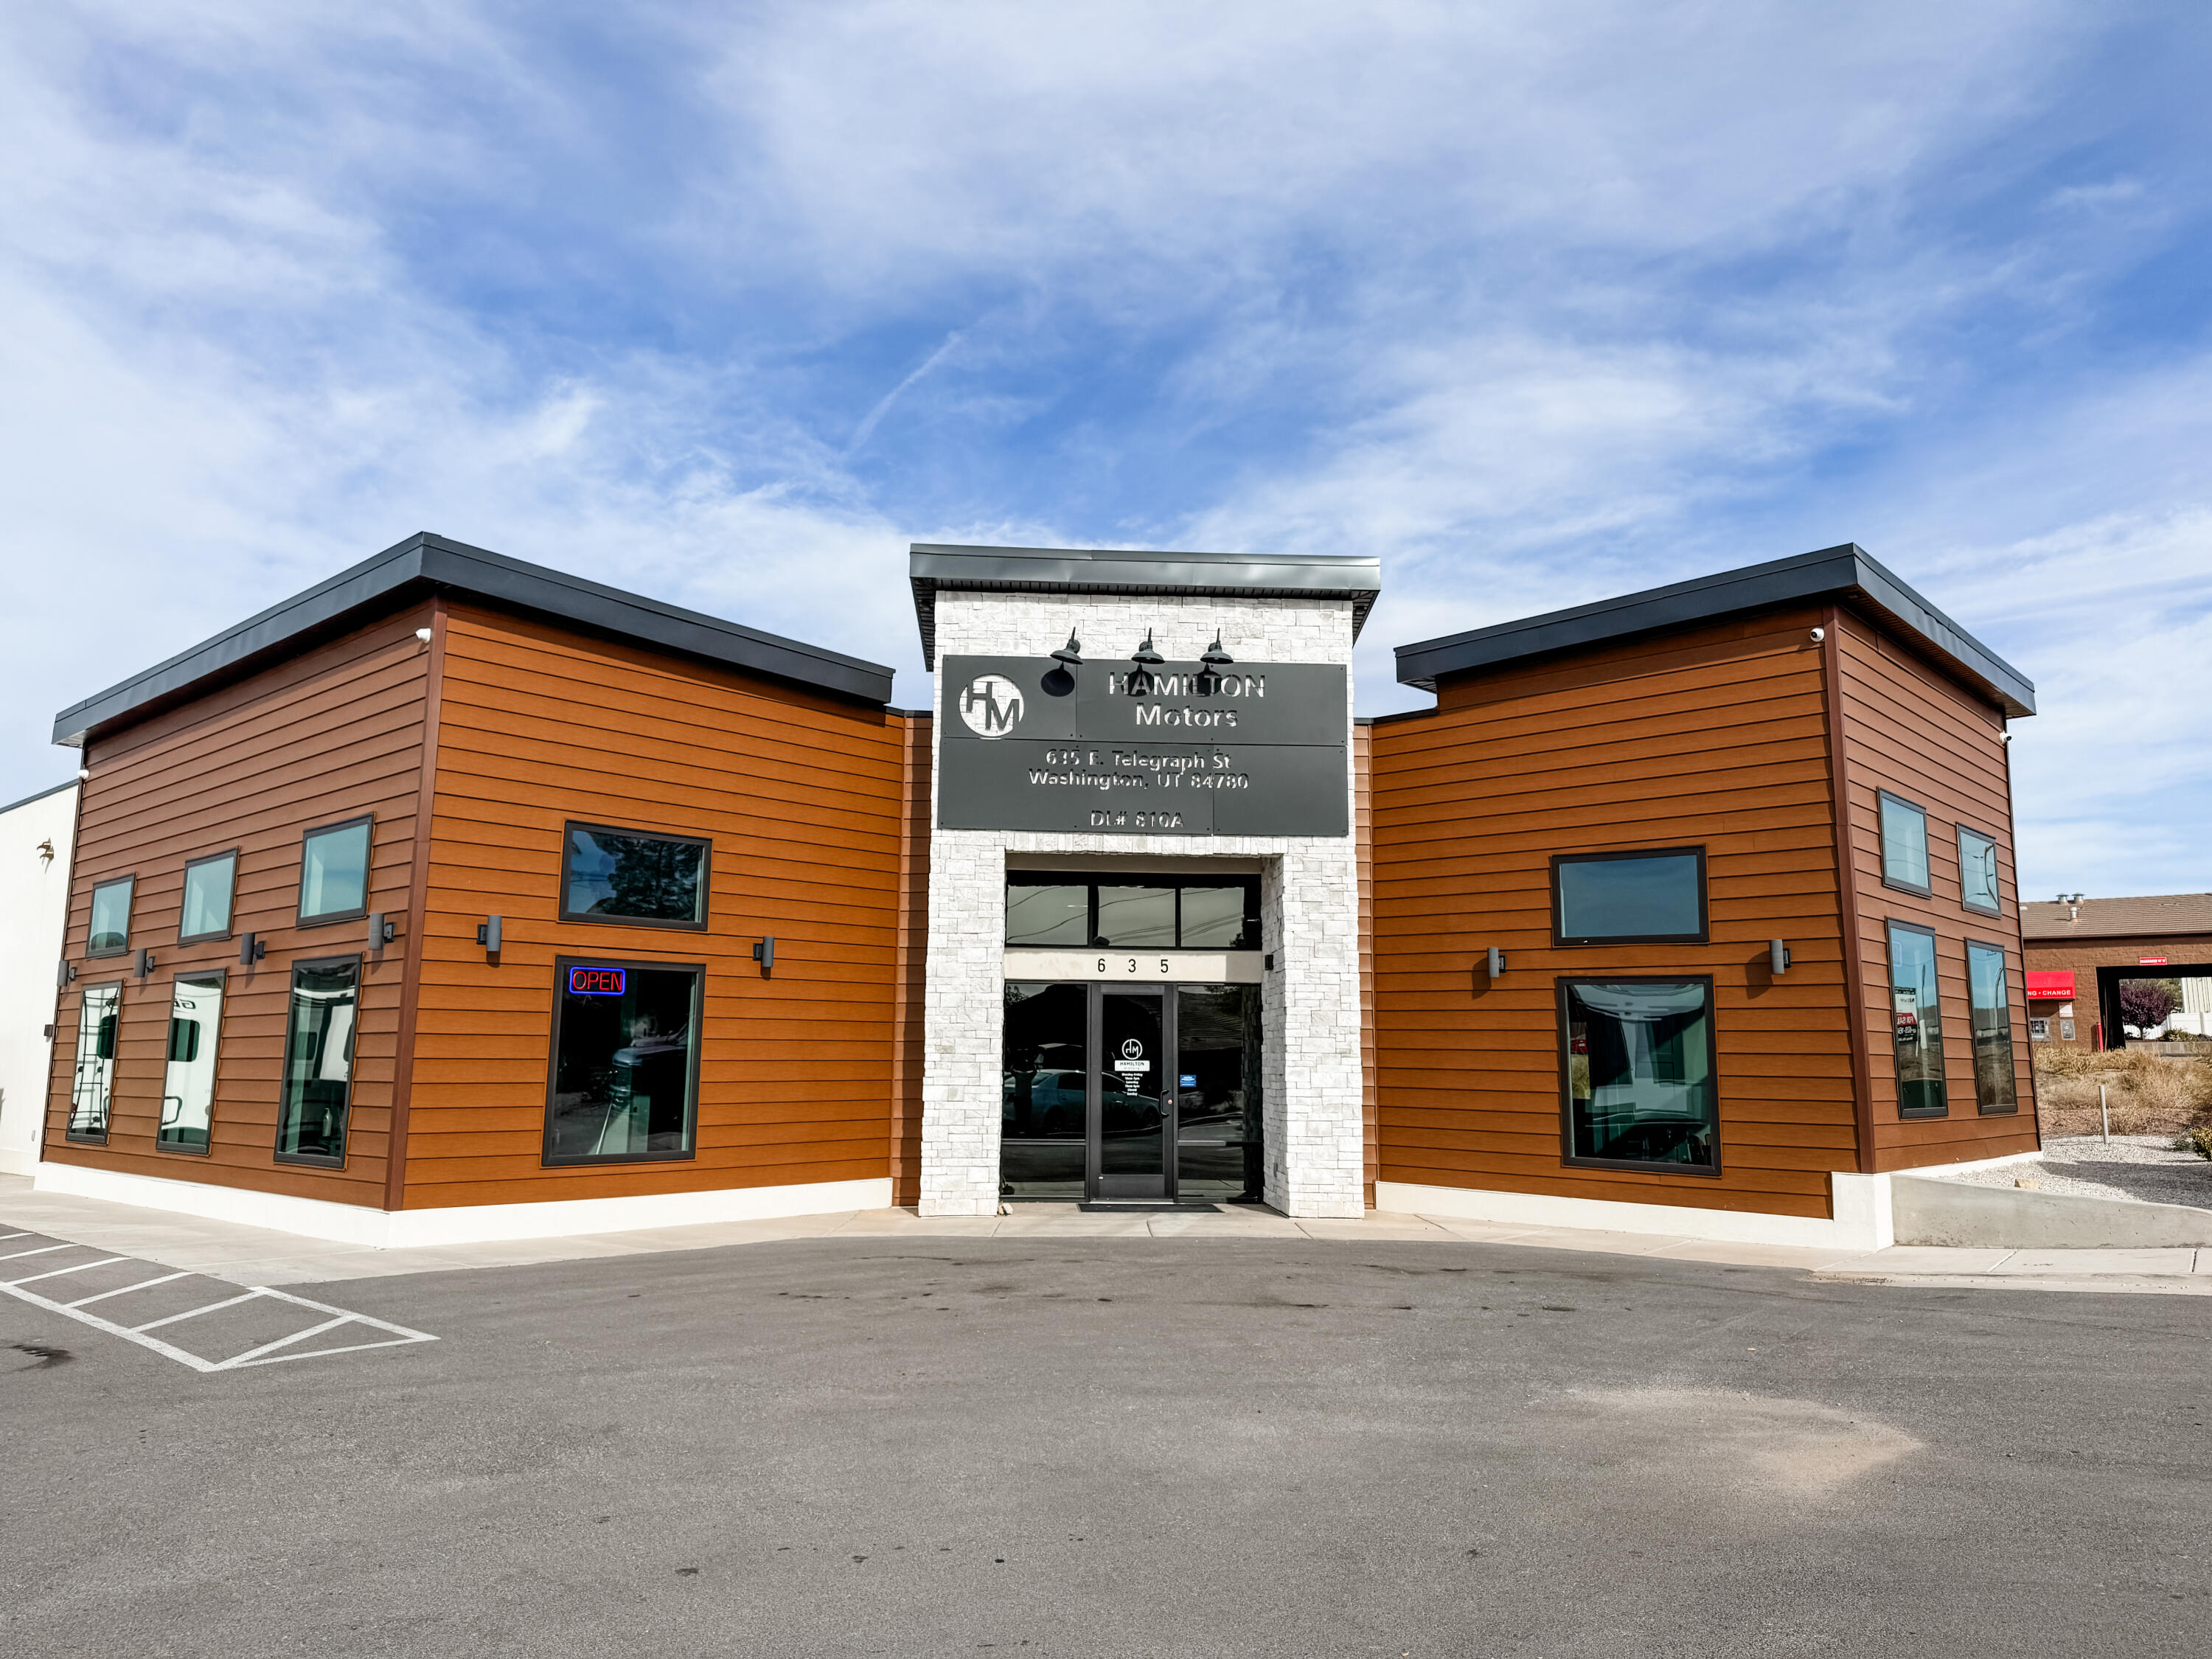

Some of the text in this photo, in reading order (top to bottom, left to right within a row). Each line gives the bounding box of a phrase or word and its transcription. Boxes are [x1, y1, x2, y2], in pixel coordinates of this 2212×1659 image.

[1109, 672, 1265, 698] HAMILTON
[1135, 702, 1238, 727] Motors
[1046, 748, 1231, 775] 635 E. Telegraph St
[1029, 768, 1249, 790] Washington, UT 84780
[1091, 810, 1184, 828] DL# 810A
[572, 971, 623, 991] OPEN
